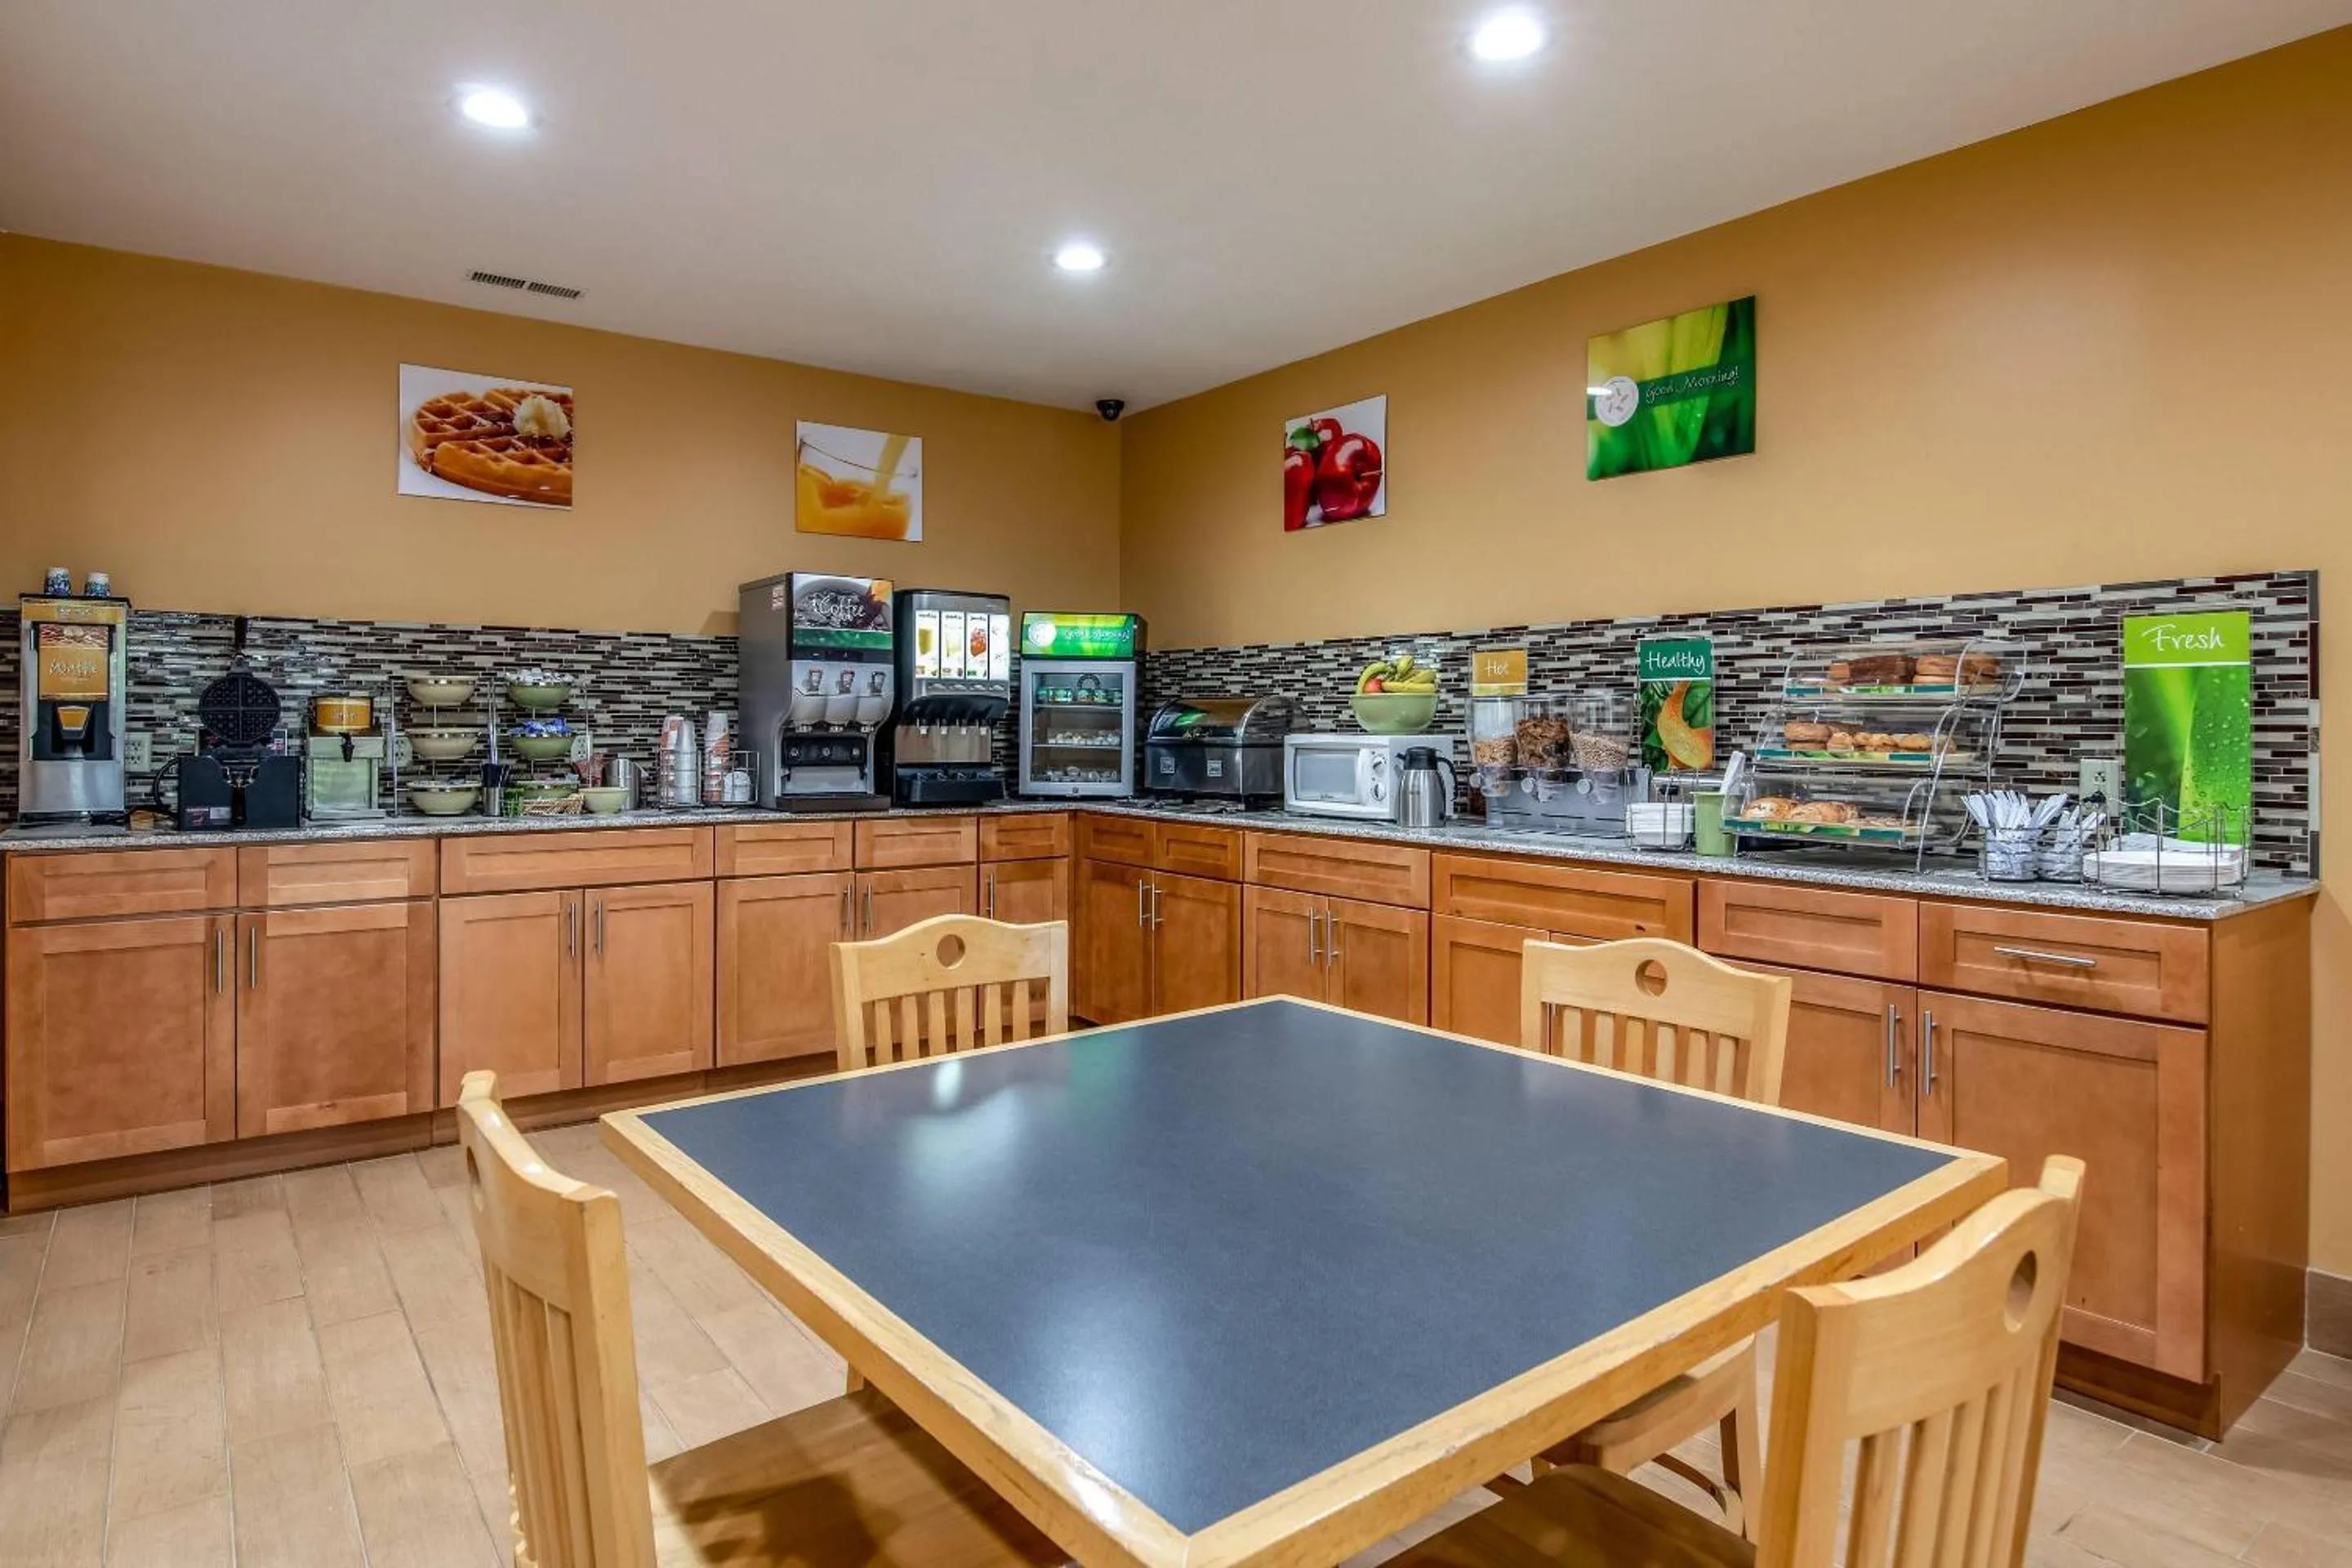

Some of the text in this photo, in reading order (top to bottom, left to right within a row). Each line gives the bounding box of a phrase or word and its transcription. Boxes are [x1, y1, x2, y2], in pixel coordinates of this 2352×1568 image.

[817, 593, 866, 619] Coffee
[2141, 623, 2225, 652] Fresh
[1646, 650, 1705, 675] Healthy
